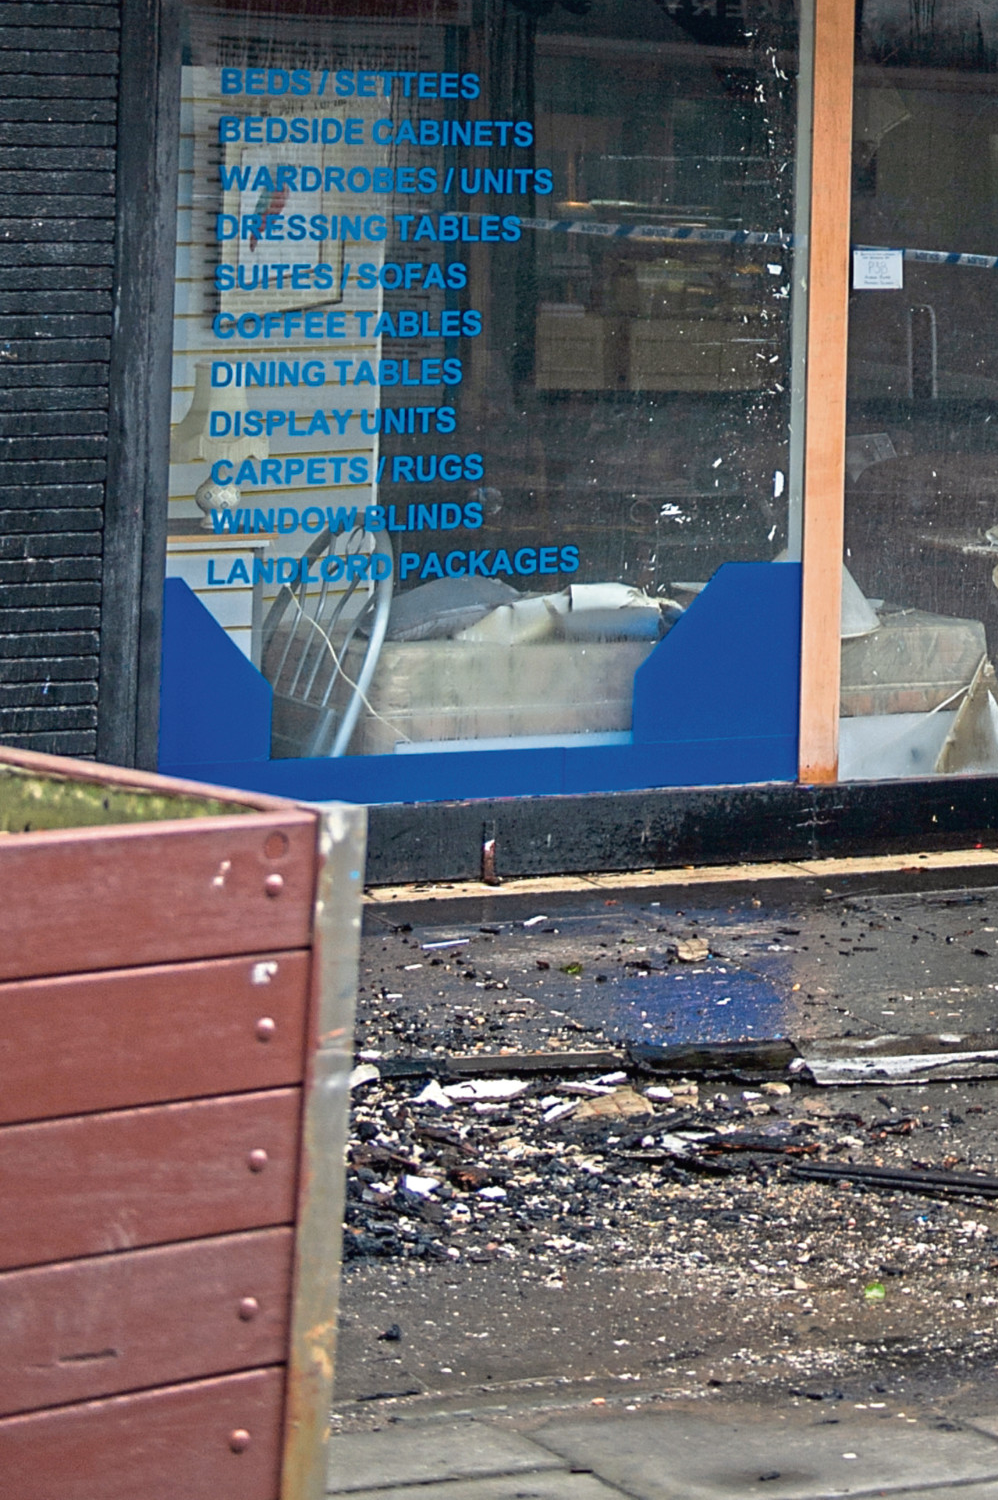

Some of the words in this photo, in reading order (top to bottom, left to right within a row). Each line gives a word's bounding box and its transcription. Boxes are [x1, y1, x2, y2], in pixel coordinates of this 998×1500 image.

[221, 67, 312, 96] BEDS
[335, 70, 481, 100] SETTEES
[219, 116, 365, 146] BEDSIDE
[371, 118, 534, 148] CABINETS
[219, 164, 438, 195] WARDROBES
[460, 168, 554, 196] UNITS
[216, 212, 388, 242] DRESSING
[393, 214, 522, 243] TABLES
[213, 263, 334, 292] SUITES
[355, 262, 467, 291] SOFAS
[212, 311, 347, 341] COFFEE
[353, 310, 483, 339] TABLES
[210, 360, 328, 389] DINING
[332, 358, 463, 387] TABLES
[209, 408, 355, 438] DISPLAY
[359, 406, 457, 436] UNITS
[210, 457, 369, 487] CARPETS
[391, 454, 484, 484] RUGS
[210, 505, 359, 536] WINDOW
[363, 502, 484, 532] BLINDS
[206, 552, 394, 586] LANDLORD
[399, 545, 580, 580] PACKAGES
